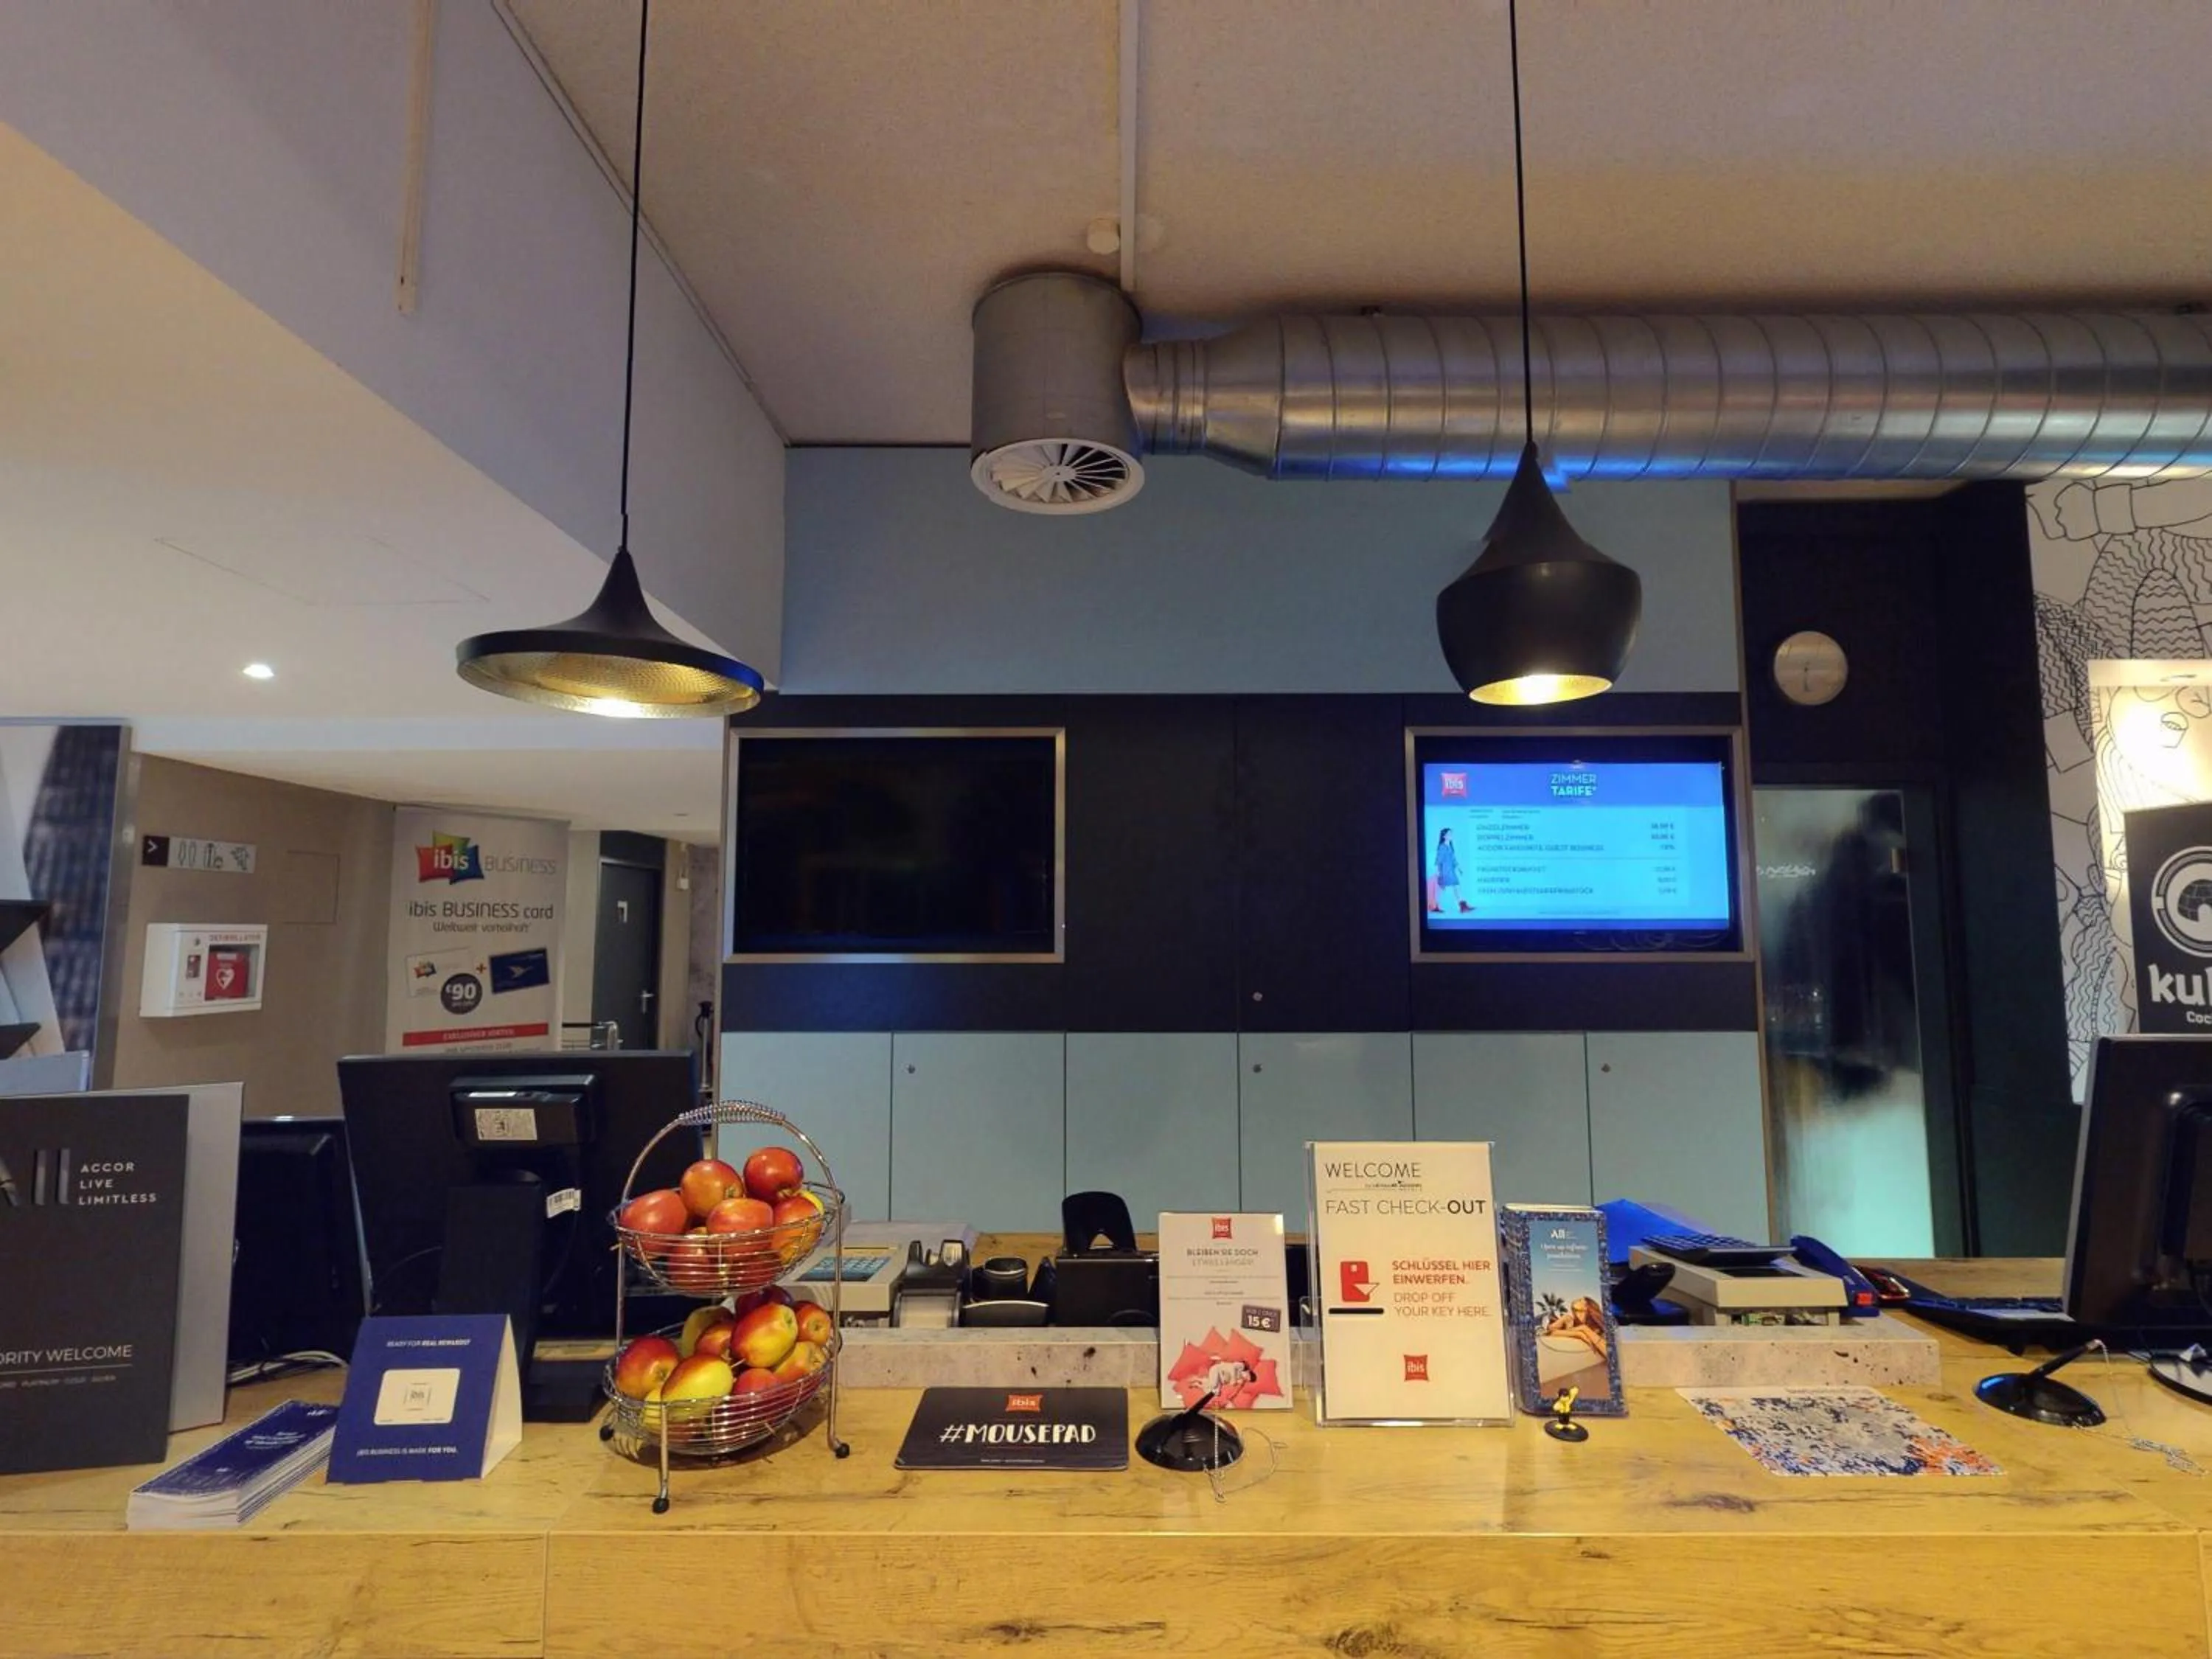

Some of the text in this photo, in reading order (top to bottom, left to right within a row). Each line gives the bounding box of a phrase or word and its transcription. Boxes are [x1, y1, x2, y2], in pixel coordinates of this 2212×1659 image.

[1551, 773, 1597, 785] ZIMMER
[434, 850, 470, 870] ibis
[408, 901, 554, 919] ibis BUSINESS card
[80, 1162, 135, 1173] ACCOR
[1326, 1163, 1422, 1178] WELCOME
[80, 1179, 114, 1189] LIVE
[78, 1193, 157, 1206] LIMITLESS
[1326, 1200, 1486, 1214] FAST CHECK-OUT
[1392, 1258, 1491, 1270] SCHLÜSSEL HIER
[1394, 1292, 1456, 1303] DROP OFF
[1395, 1306, 1429, 1316] YOUR
[1431, 1306, 1455, 1316] KEY
[46, 1344, 133, 1362] WELCOME
[1407, 1361, 1425, 1373] ibis
[1012, 1398, 1036, 1407] ibis
[939, 1424, 1096, 1443] #MOUSEPAD
